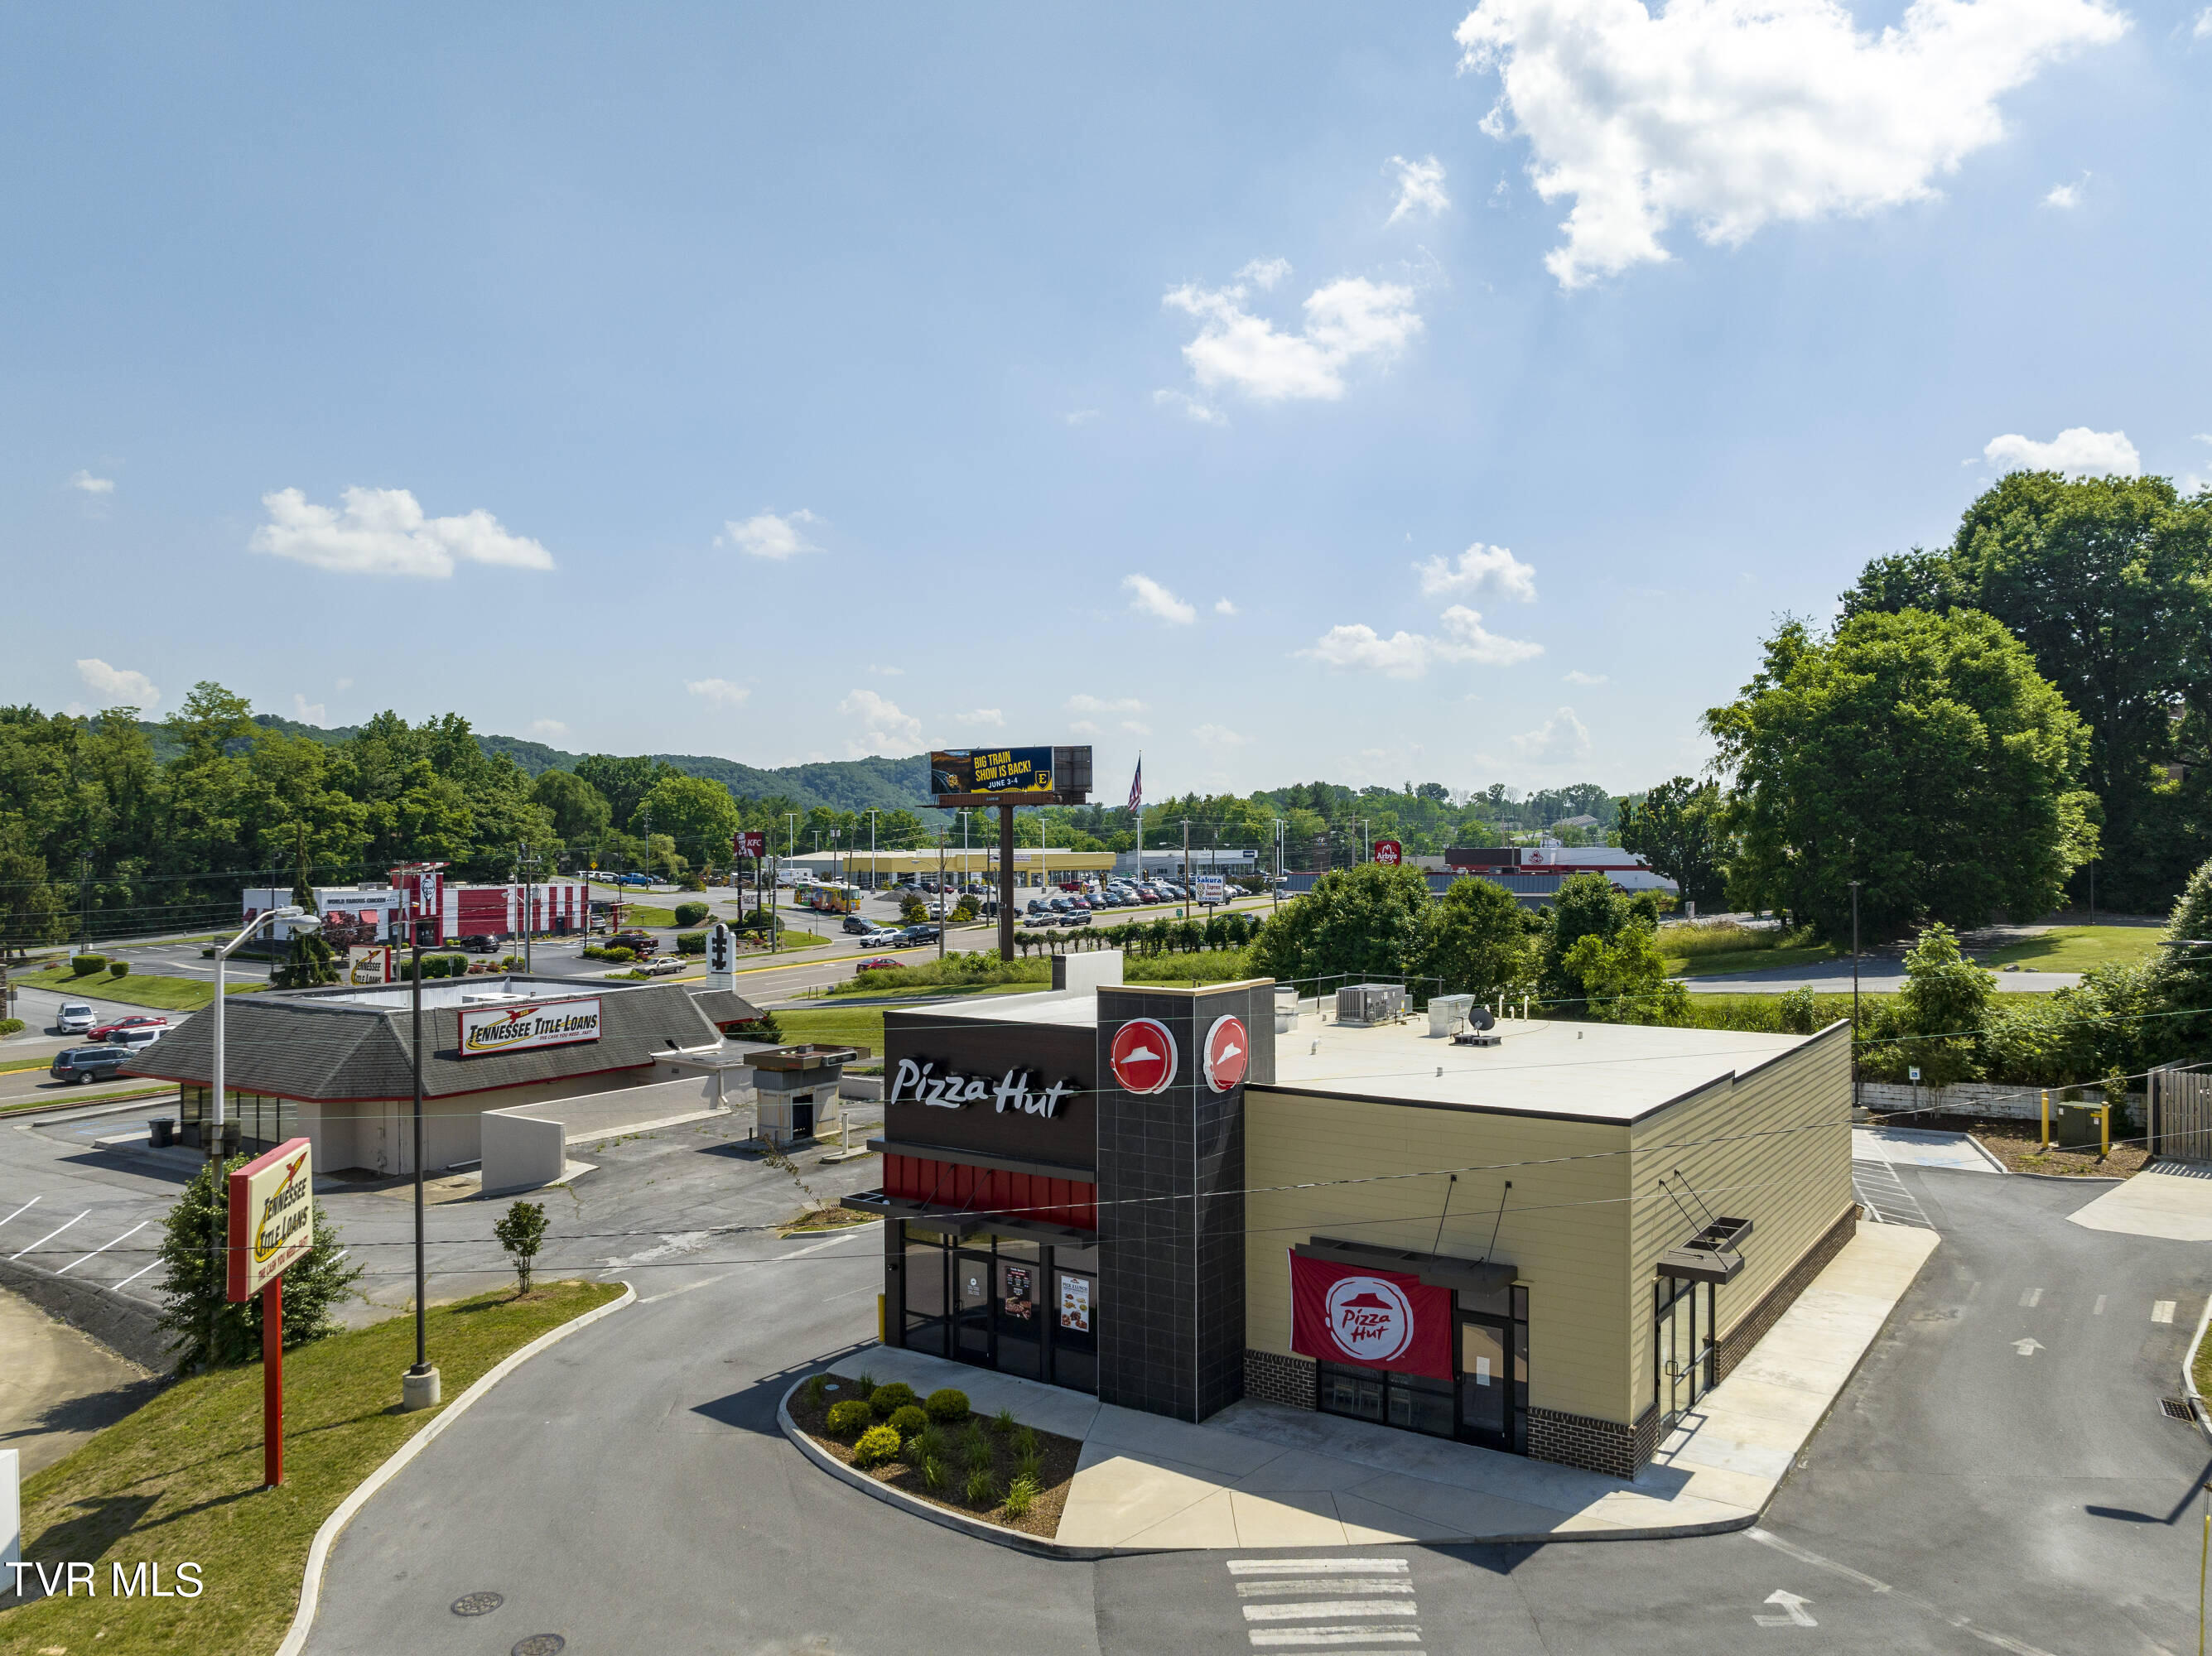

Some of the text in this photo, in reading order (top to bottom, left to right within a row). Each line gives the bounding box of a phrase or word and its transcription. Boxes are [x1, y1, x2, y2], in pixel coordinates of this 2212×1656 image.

[974, 751, 1011, 769] BIG TRAIN
[976, 760, 1032, 782] SHOW IS BACK!
[988, 777, 1018, 789] JUNE 3-4
[1376, 852, 1398, 861] Arby's
[470, 1014, 598, 1043] TENNESSEE TITLE LOANS
[891, 1059, 1074, 1118] Pizza Hut
[264, 1177, 307, 1225] TENNESSEE
[258, 1206, 309, 1258] TITLE LOANS
[1342, 1308, 1391, 1329] Pizza
[1350, 1325, 1390, 1343] Hut
